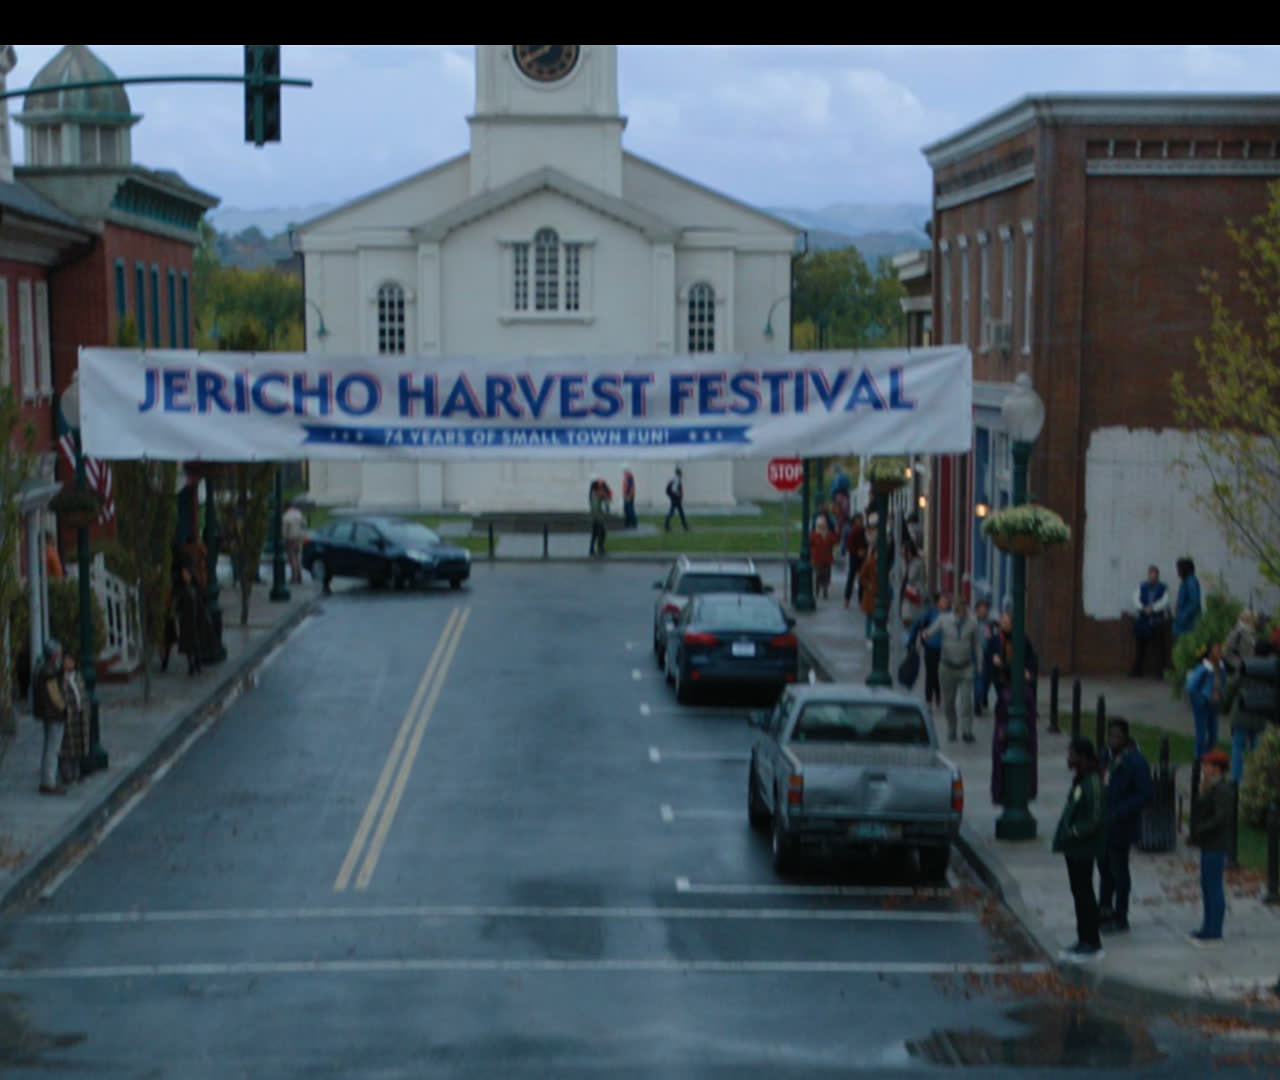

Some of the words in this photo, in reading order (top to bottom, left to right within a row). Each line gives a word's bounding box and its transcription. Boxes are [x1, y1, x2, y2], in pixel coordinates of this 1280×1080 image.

[138, 368, 382, 416] JERICHO
[398, 371, 655, 419] HARVEST
[670, 366, 918, 416] FESTIVAL
[384, 429, 403, 445] 74
[410, 430, 465, 445] YEARS
[472, 430, 494, 445] OF
[502, 430, 558, 446] SMALL
[568, 430, 620, 445] TOWN
[627, 430, 670, 444] FUN!
[770, 464, 803, 480] STOP
